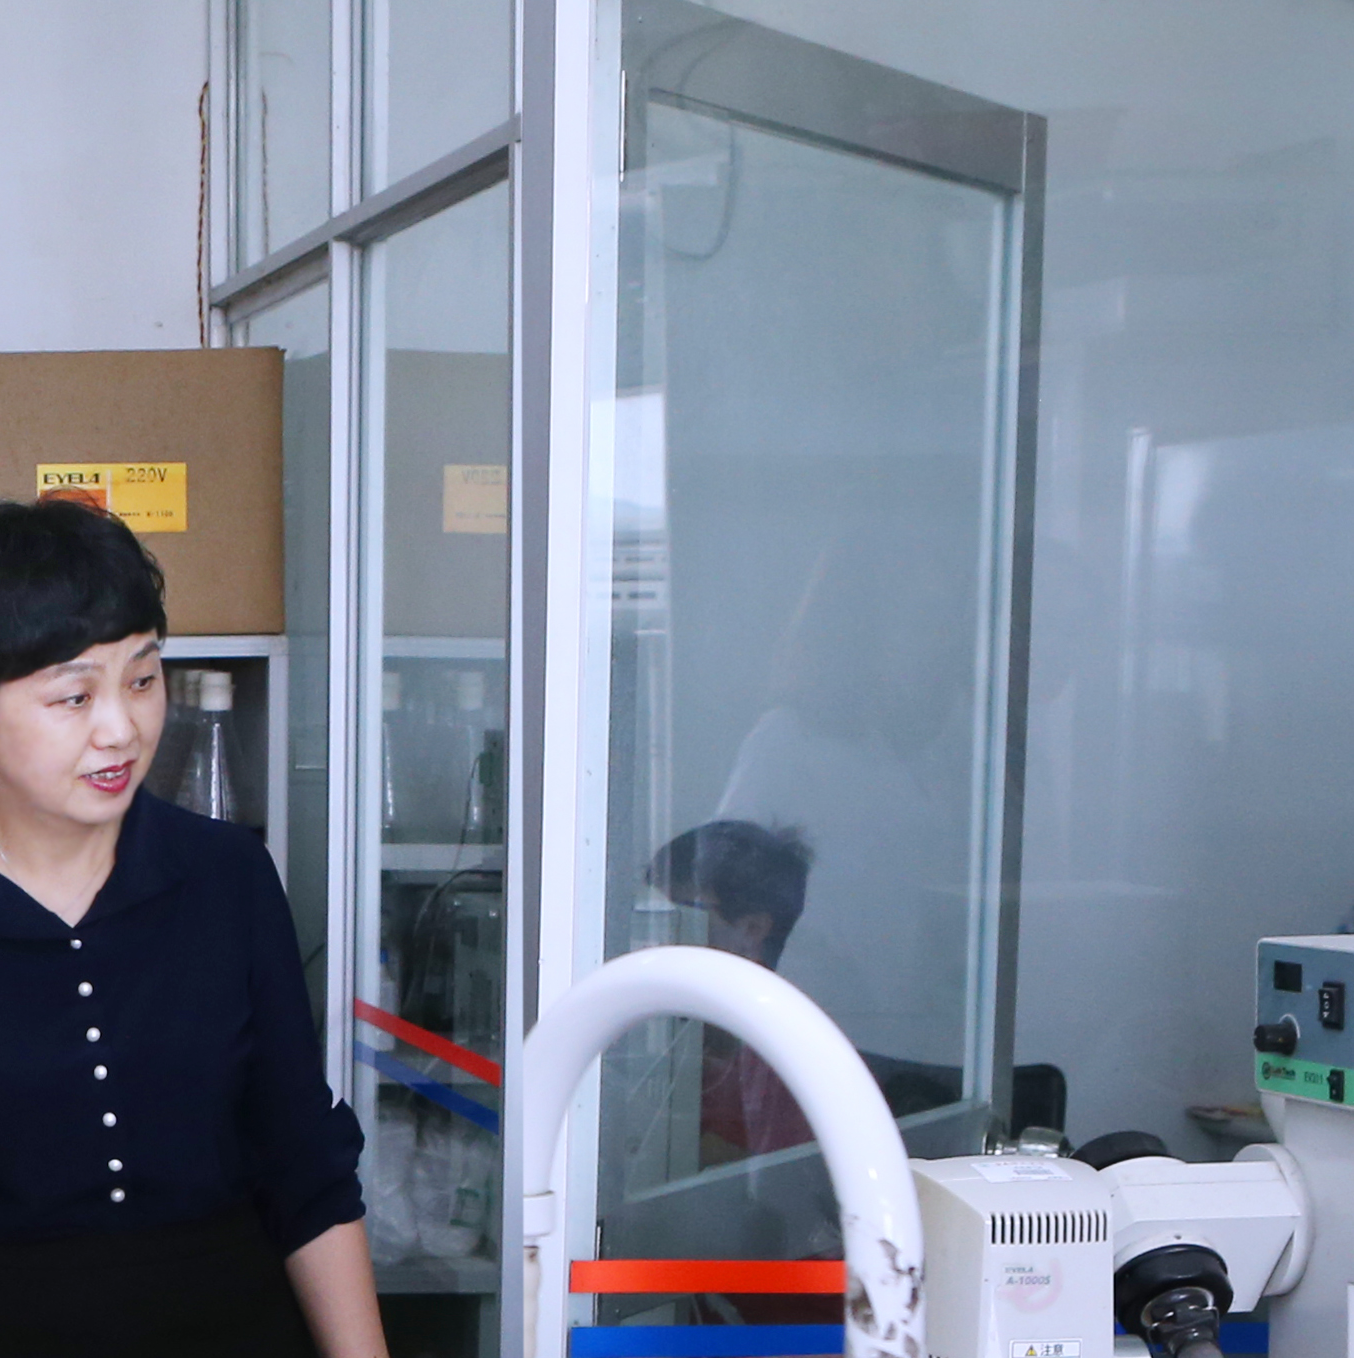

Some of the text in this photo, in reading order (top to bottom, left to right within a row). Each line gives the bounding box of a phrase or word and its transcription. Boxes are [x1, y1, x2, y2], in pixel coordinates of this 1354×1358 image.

[43, 472, 100, 485] EYELA
[126, 467, 168, 483] 220V
[1040, 1343, 1064, 1357] 注意
